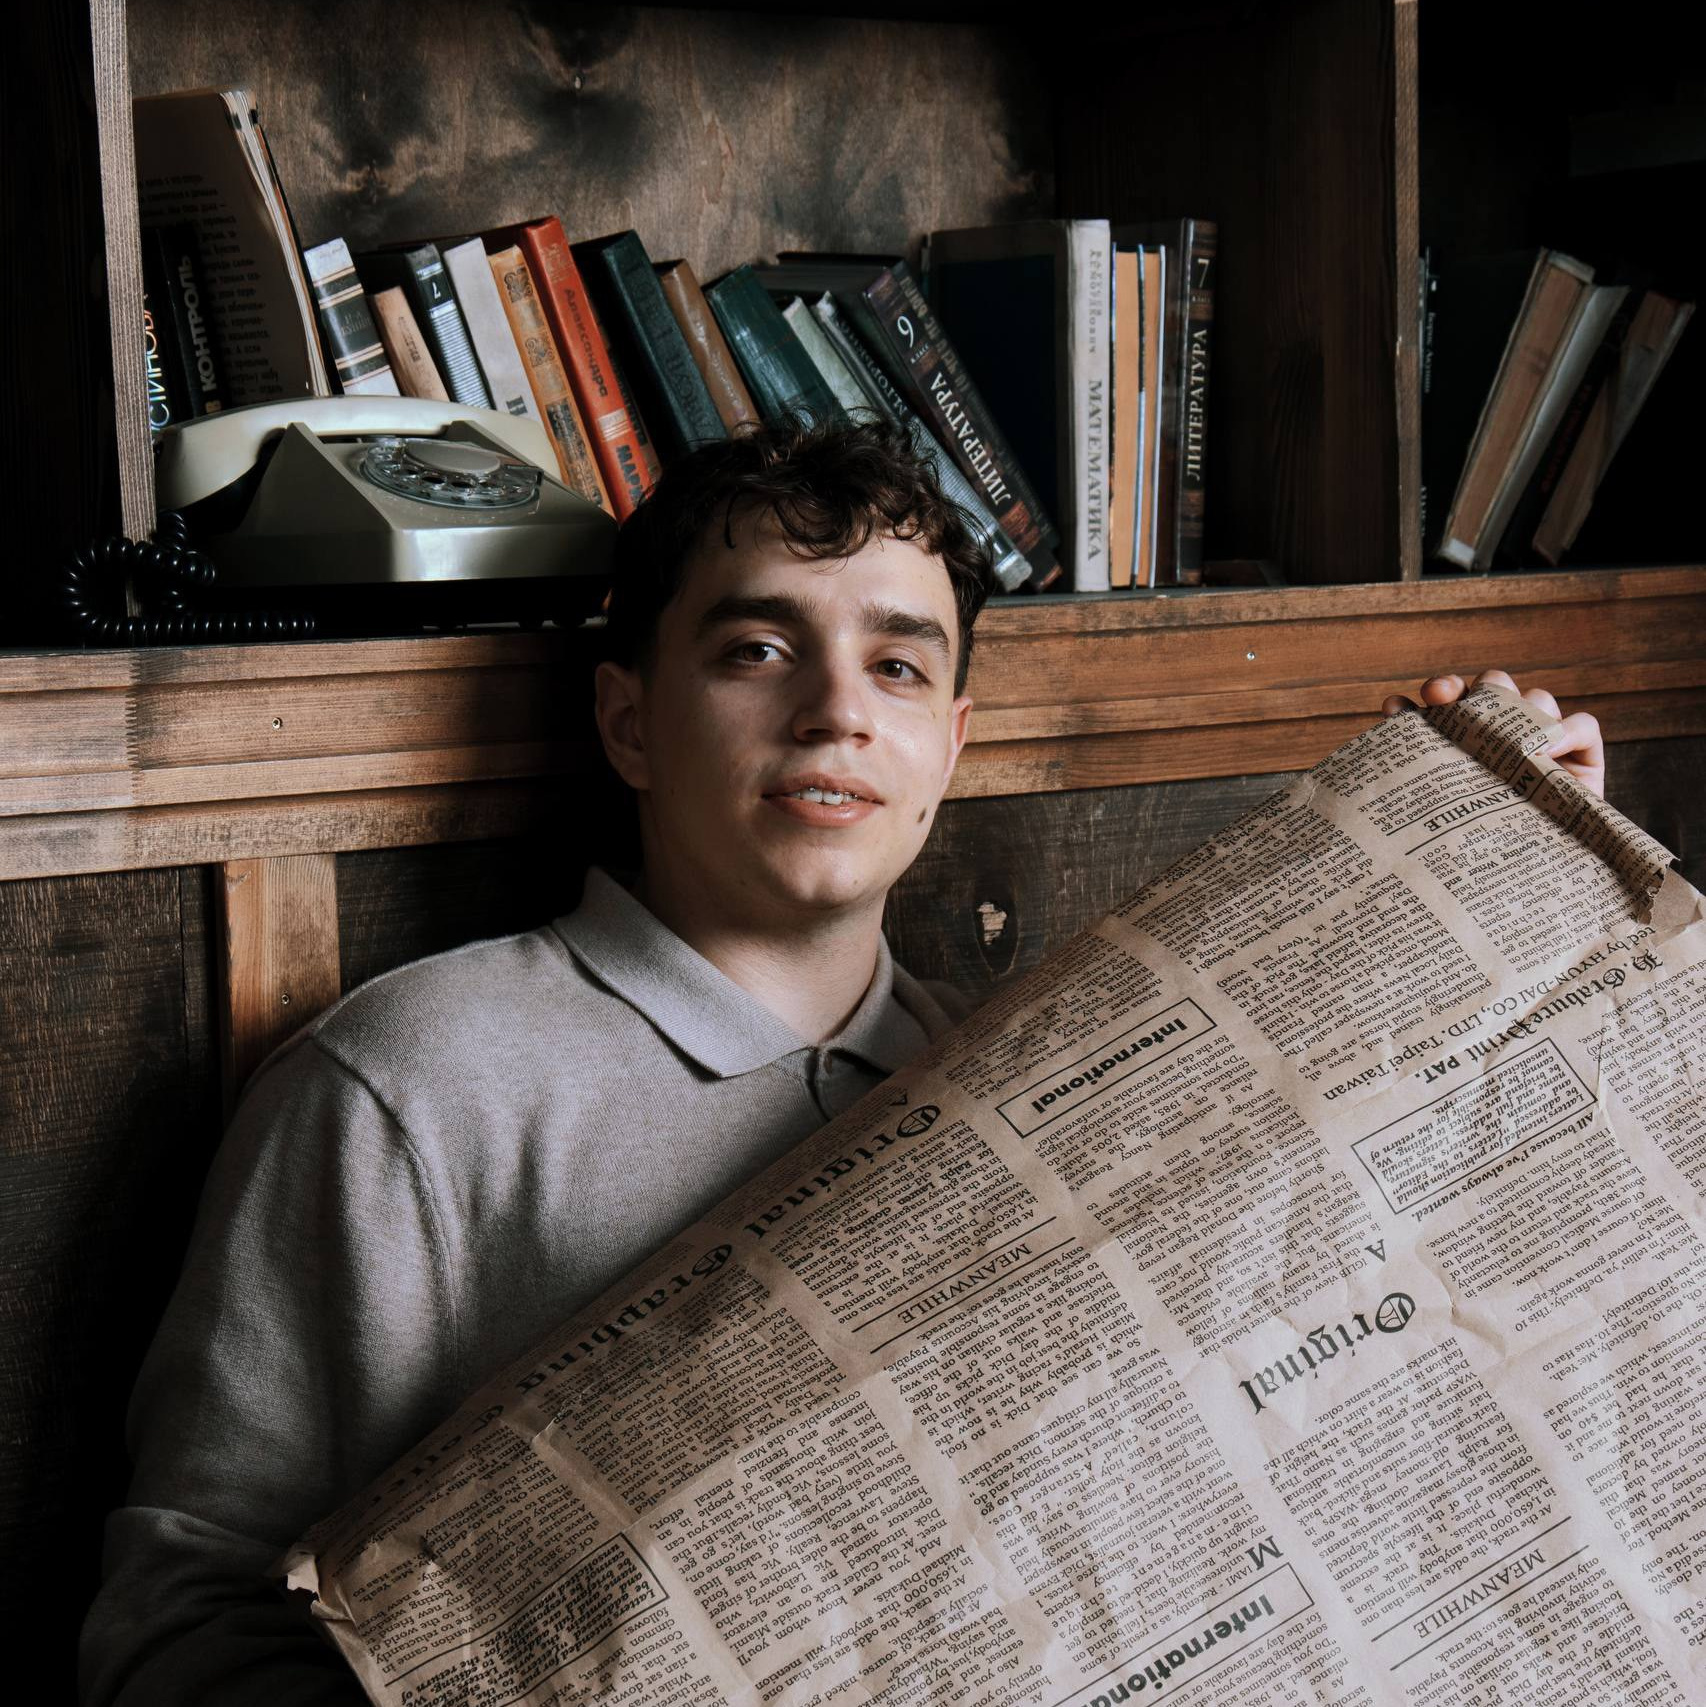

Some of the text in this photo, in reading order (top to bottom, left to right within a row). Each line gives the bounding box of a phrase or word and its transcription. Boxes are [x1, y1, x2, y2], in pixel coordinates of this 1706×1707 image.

[1197, 257, 1210, 288] 7
[179, 273, 216, 391] КОНТРОЛЬ
[897, 315, 913, 347] 9
[1187, 329, 1206, 480] ЛИТЕРАТУРА
[930, 372, 1011, 504] ЛИТЕРАТУРА
[1087, 380, 1102, 560] МАТЕМАТИКА
[1423, 768, 1535, 831] MEANWHILE
[1477, 875, 1586, 930] by efficiency experts
[1604, 936, 1630, 958] by
[1518, 950, 1606, 1003] HYUN-DAI
[1480, 997, 1517, 1015] CO.,
[1297, 971, 1485, 1074] thunderingly stupid horses are going to
[1441, 1012, 1482, 1036] LTD.
[1030, 1017, 1188, 1114] International
[1387, 1035, 1443, 1070] Taipei
[1322, 1063, 1388, 1100] Taiwan
[1414, 1055, 1460, 1083] PAT.
[1181, 1090, 1196, 1101] in
[1564, 1085, 1579, 1097] be
[1152, 1099, 1181, 1116] 1985,
[1513, 1092, 1561, 1129] addressed
[1575, 1110, 1593, 1130] All
[1122, 1114, 1152, 1136] asked
[1503, 1114, 1548, 1145] intended
[1528, 1123, 1577, 1153] because
[1090, 1131, 1122, 1153] 2,005
[1452, 1150, 1464, 1160] to
[1488, 1136, 1504, 1152] for
[1288, 1162, 1325, 1187] Shortly
[1429, 1145, 1488, 1184] publication
[1432, 1158, 1449, 1172] the
[1460, 1163, 1504, 1193] always
[1237, 1200, 1256, 1214] the
[1255, 1183, 1289, 1204] before
[1395, 1179, 1430, 1205] should
[1410, 1189, 1461, 1222] wanted.
[1199, 1210, 1238, 1238] Donald
[1457, 1174, 1647, 1289] about 38th, prompting me to reluctantly
[1636, 1203, 1675, 1230] Me: No?
[515, 1107, 939, 1395] Original Graphing
[1166, 1232, 1200, 1254] Regan
[896, 1242, 1031, 1324] MEANWHILE
[1314, 1274, 1339, 1292] view
[1514, 1221, 1691, 1332] Him: I'm tellin' ya. Definitely. This 10
[1192, 1246, 1361, 1348] the First Family's faith in astrology
[1282, 1295, 1301, 1309] the
[1300, 1287, 1313, 1302] of
[1249, 1305, 1283, 1329] matter
[1197, 1341, 1221, 1358] that
[1220, 1324, 1251, 1345] holds
[1238, 1292, 1416, 1414] Original
[1555, 1399, 1622, 1440] bet $40 on
[1001, 1424, 1208, 1550] Religion Editor. Needless to say, he was
[466, 1503, 585, 1597] Accounts Payable, and
[1042, 1491, 1245, 1617] recommended by efficiency experts
[1345, 1475, 1549, 1603] Michael Dukakis. The track is a
[1353, 1486, 1557, 1615] in 1,650,000 that anybody will mention
[714, 1496, 933, 1630] operator named Vic Leibowitz, who
[722, 1506, 941, 1642] Dick introduced me to an elevator
[1360, 1503, 1551, 1627] At the track, the odds are less than one
[1412, 1547, 1546, 1638] MEANWHILE
[1081, 1594, 1274, 1707] Internationa
